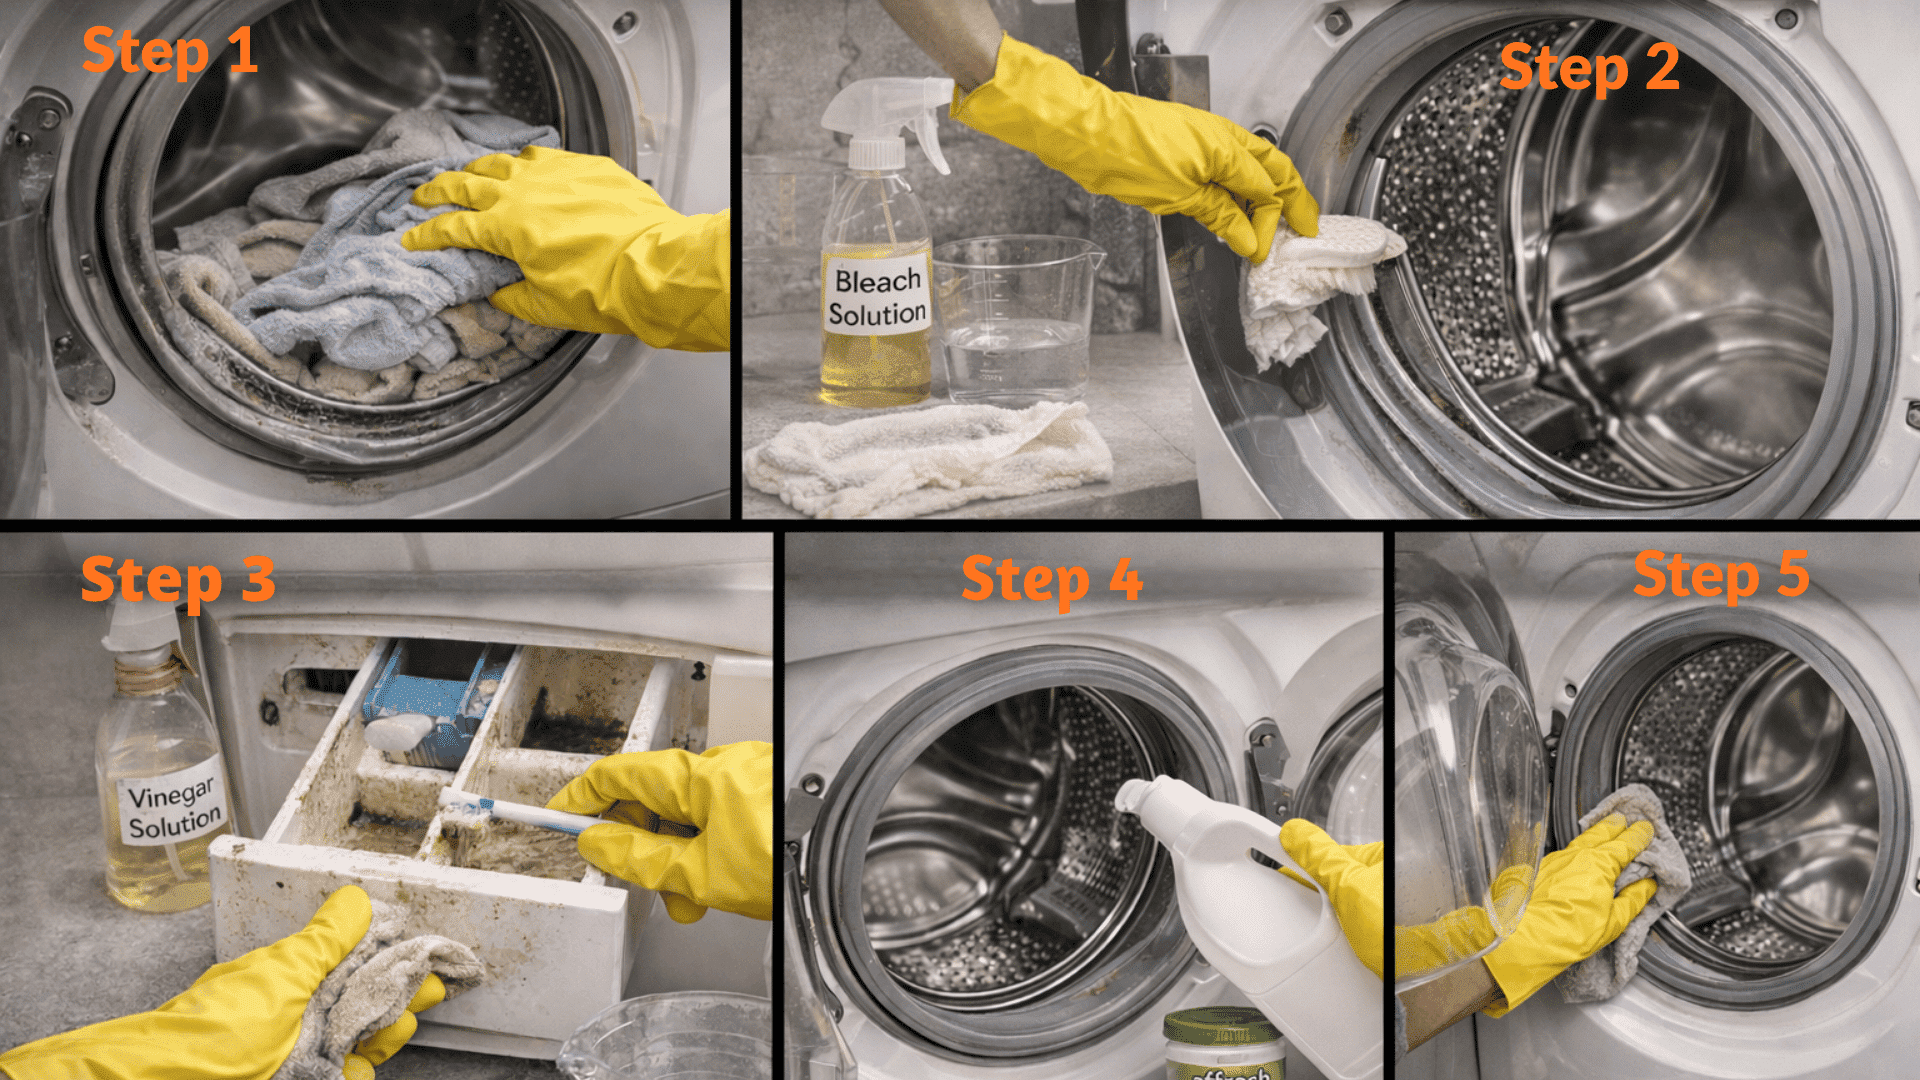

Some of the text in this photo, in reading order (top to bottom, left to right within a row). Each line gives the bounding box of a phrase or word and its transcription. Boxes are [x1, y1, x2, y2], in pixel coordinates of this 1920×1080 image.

[835, 266, 921, 293] Bleach
[829, 302, 926, 326] Solution
[128, 777, 214, 808] Vinegar
[129, 806, 221, 838] Solution
